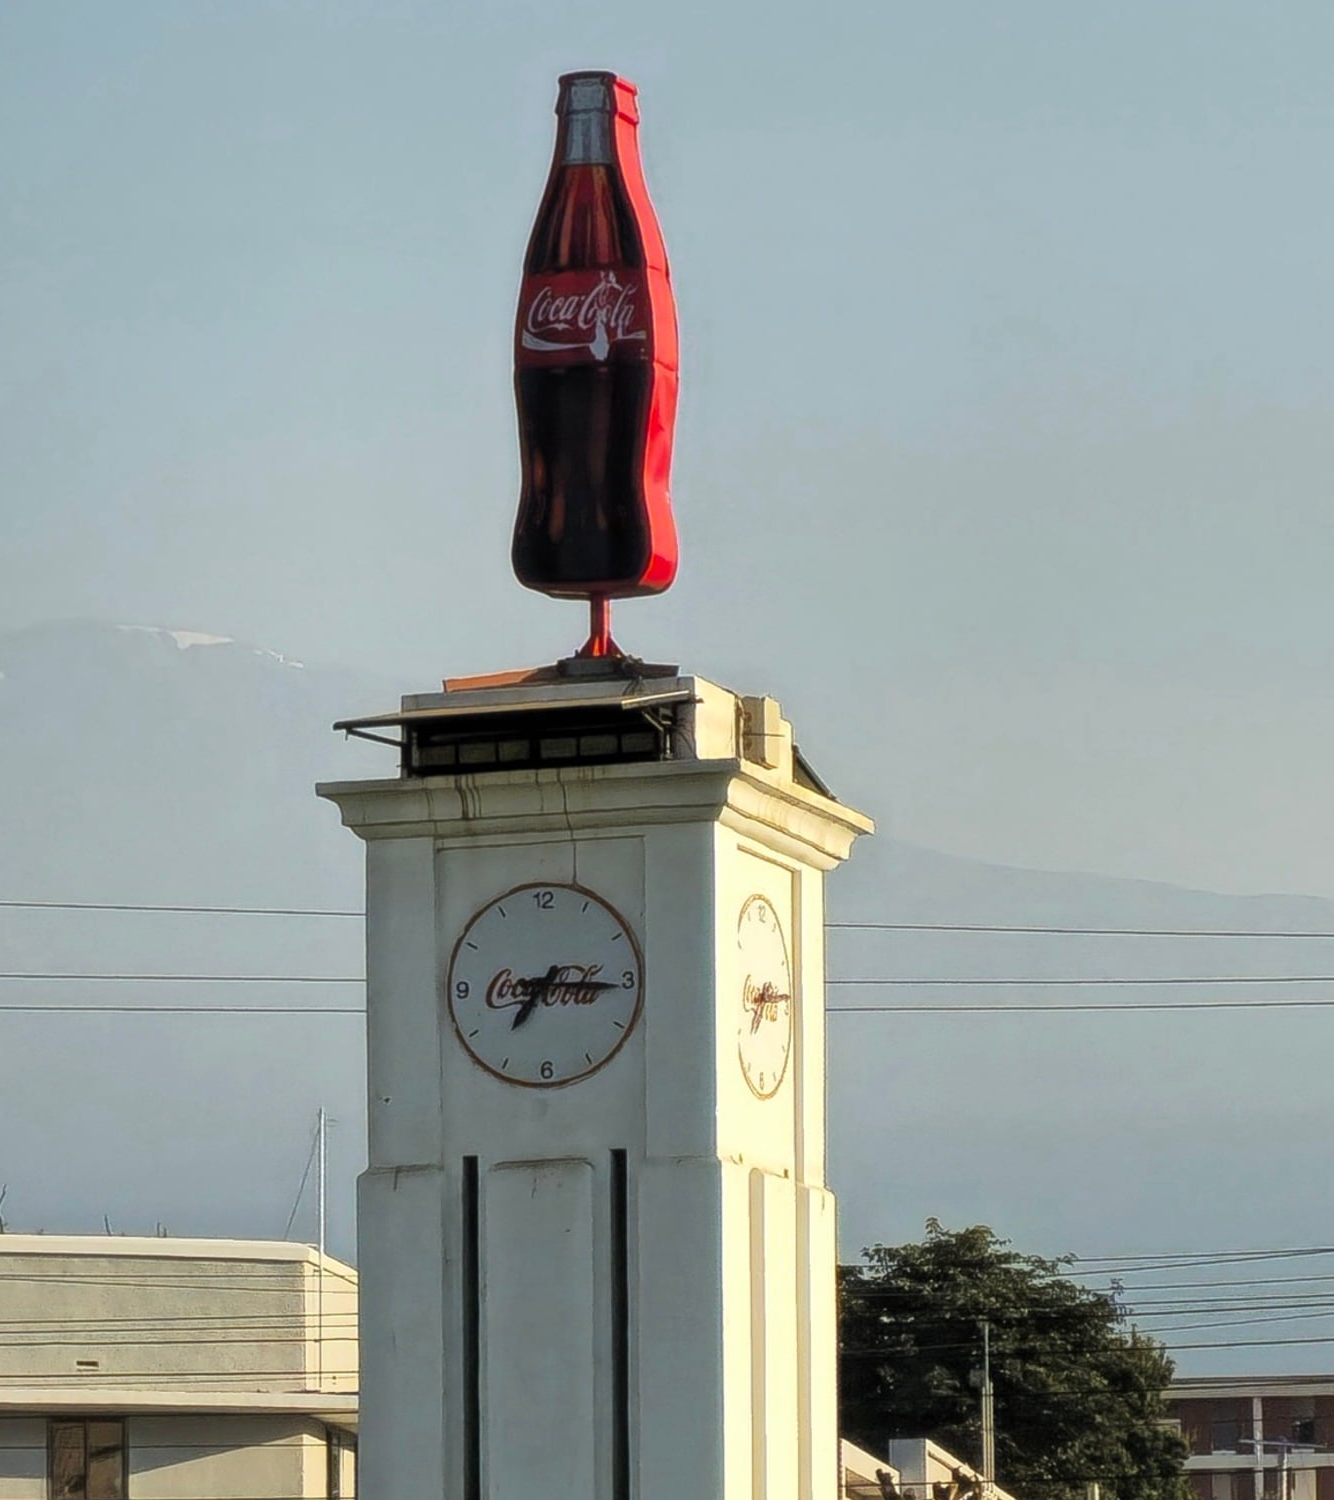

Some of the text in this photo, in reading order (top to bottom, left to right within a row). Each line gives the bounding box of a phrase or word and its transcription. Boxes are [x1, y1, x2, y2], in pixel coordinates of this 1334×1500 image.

[533, 892, 554, 909] 12
[758, 905, 766, 922] 12
[456, 981, 469, 999] 9
[621, 972, 635, 990] 3
[540, 1061, 553, 1079] 6
